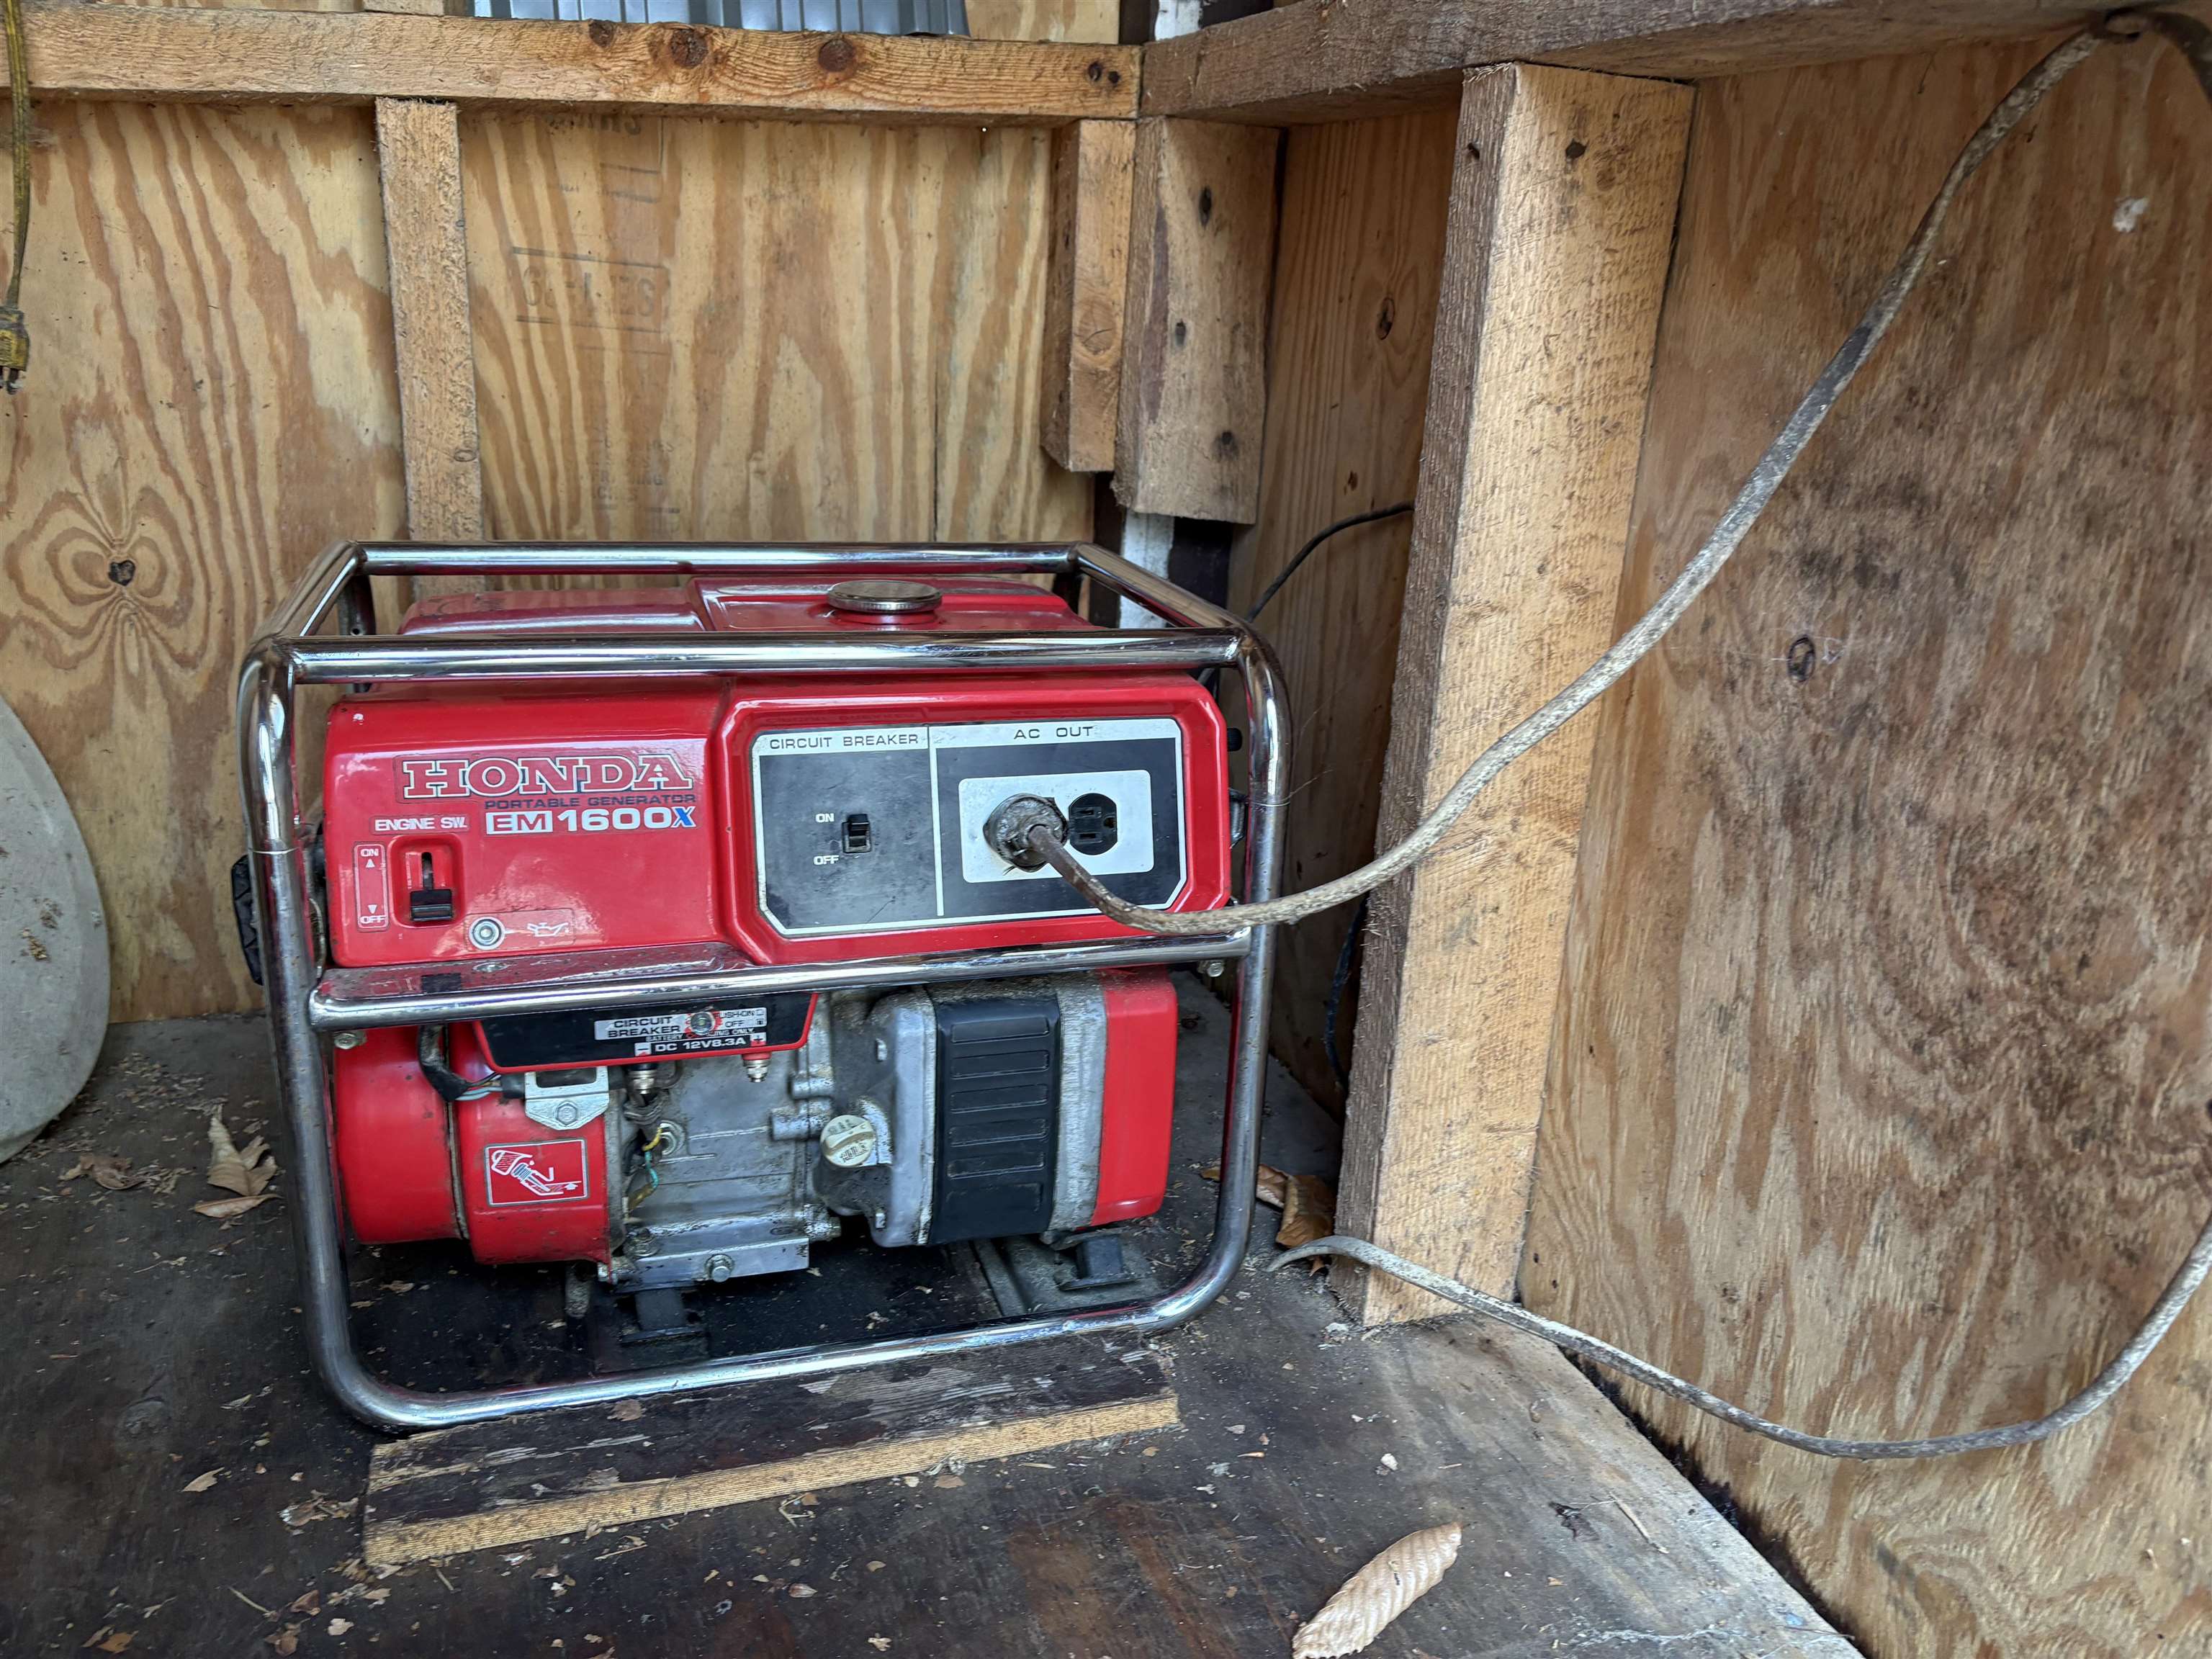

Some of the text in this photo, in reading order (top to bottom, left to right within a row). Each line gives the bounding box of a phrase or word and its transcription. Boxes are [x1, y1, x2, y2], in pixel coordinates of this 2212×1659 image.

[1014, 727, 1094, 740] AC OUT
[770, 734, 920, 750] CIRCUIT BREAKER
[402, 754, 694, 799] HONDA
[485, 793, 697, 810] PORTABLE GENERATOR
[374, 817, 435, 831] ENGINE
[816, 813, 835, 823] ON
[360, 848, 379, 857] ON
[813, 855, 840, 866] OFF
[360, 915, 387, 925] OFF
[613, 1017, 673, 1028] CIRCUIT
[608, 1025, 681, 1038] BREAKER
[655, 1043, 678, 1052] DC
